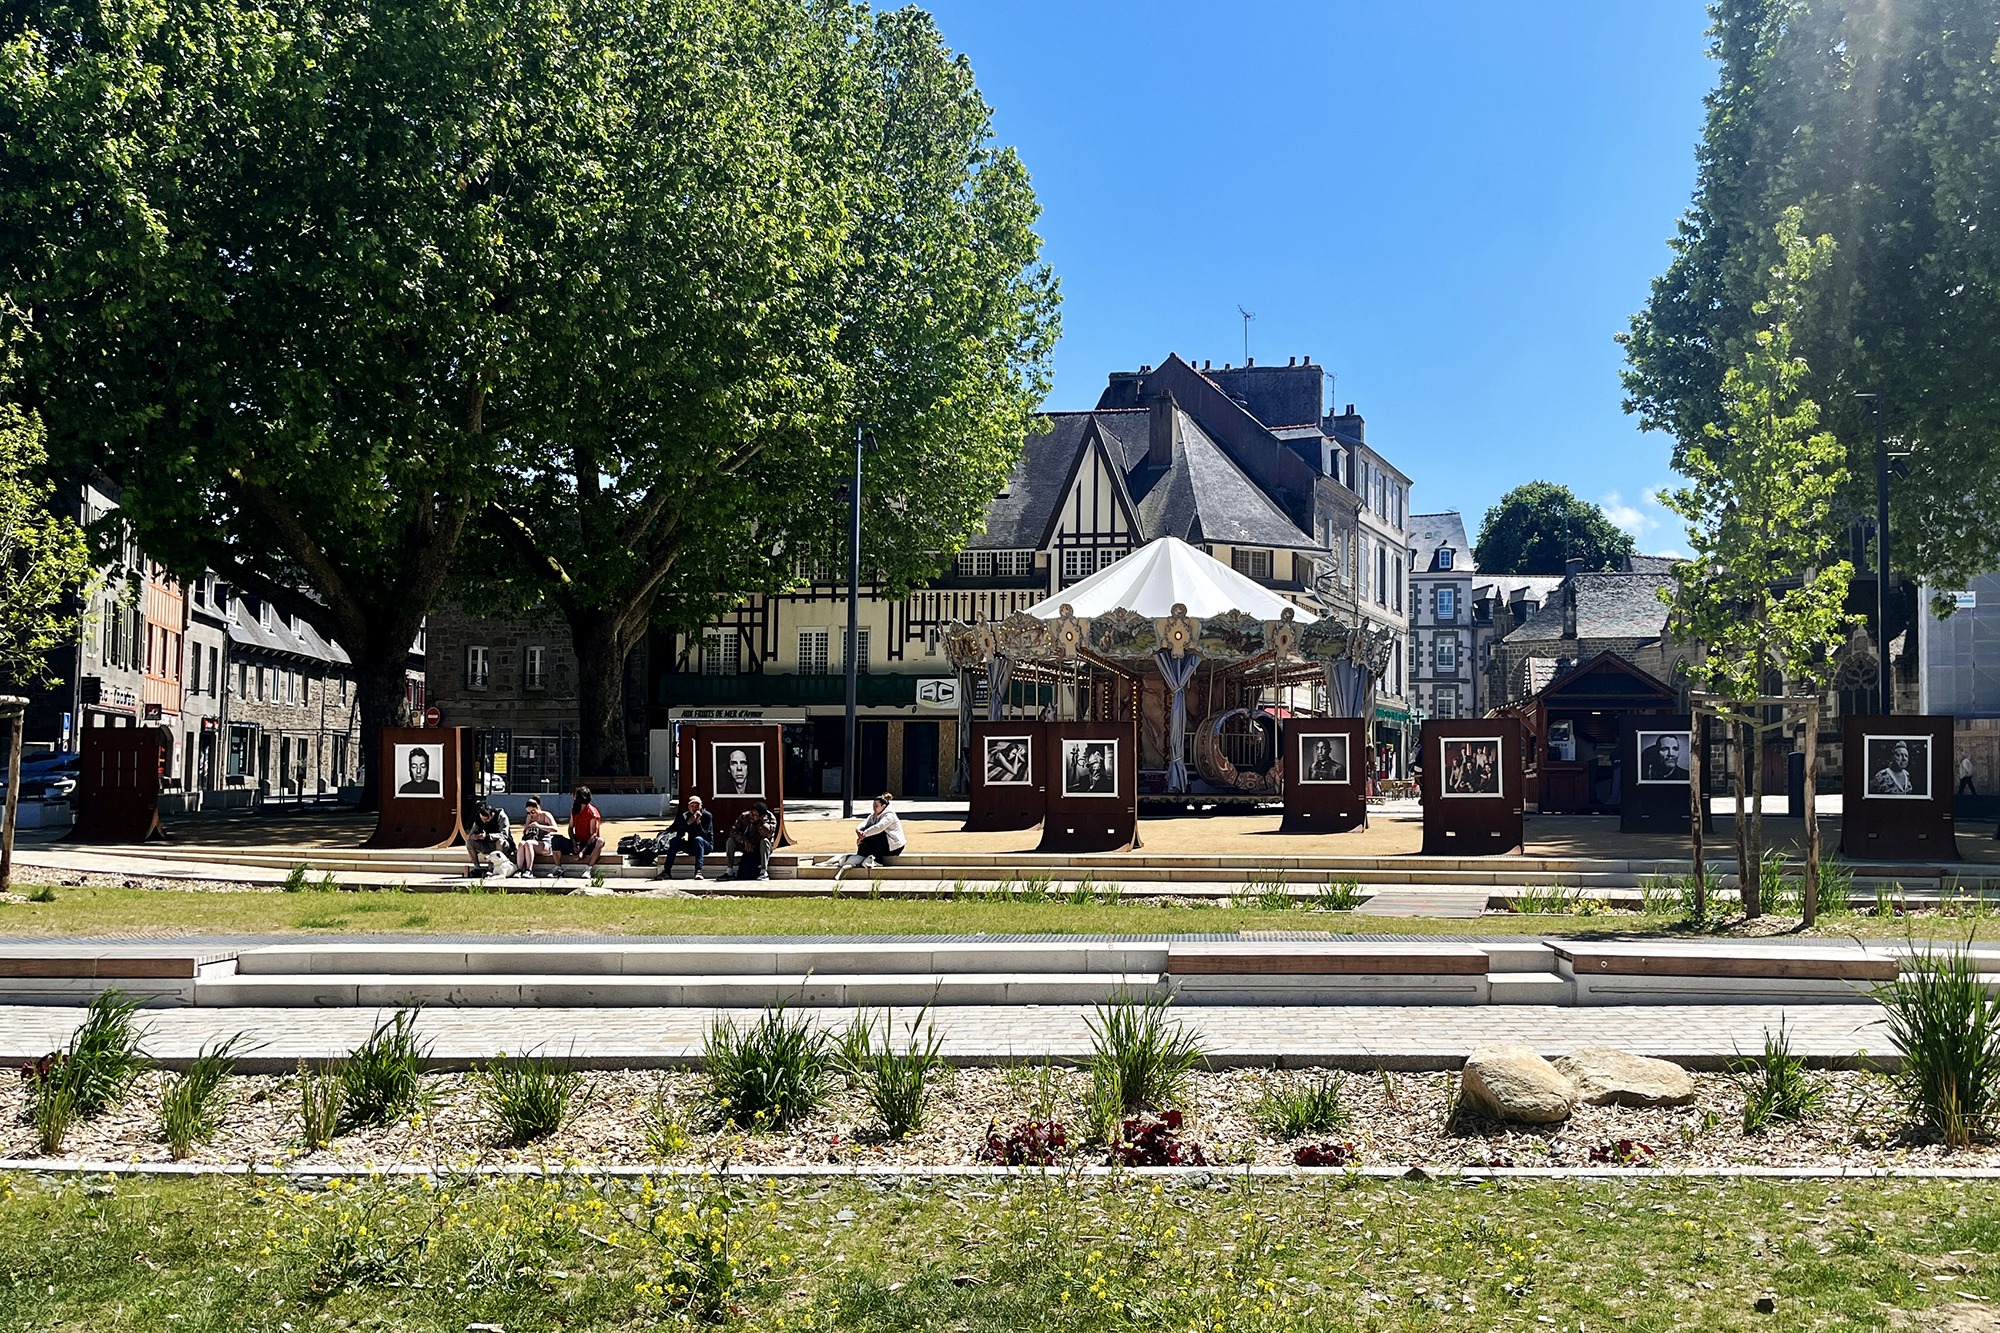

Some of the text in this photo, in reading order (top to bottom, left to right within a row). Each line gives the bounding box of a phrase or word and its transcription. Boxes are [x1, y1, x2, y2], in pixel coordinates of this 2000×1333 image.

[682, 709, 763, 718] AUX FRUITS DE MER d'Armor
